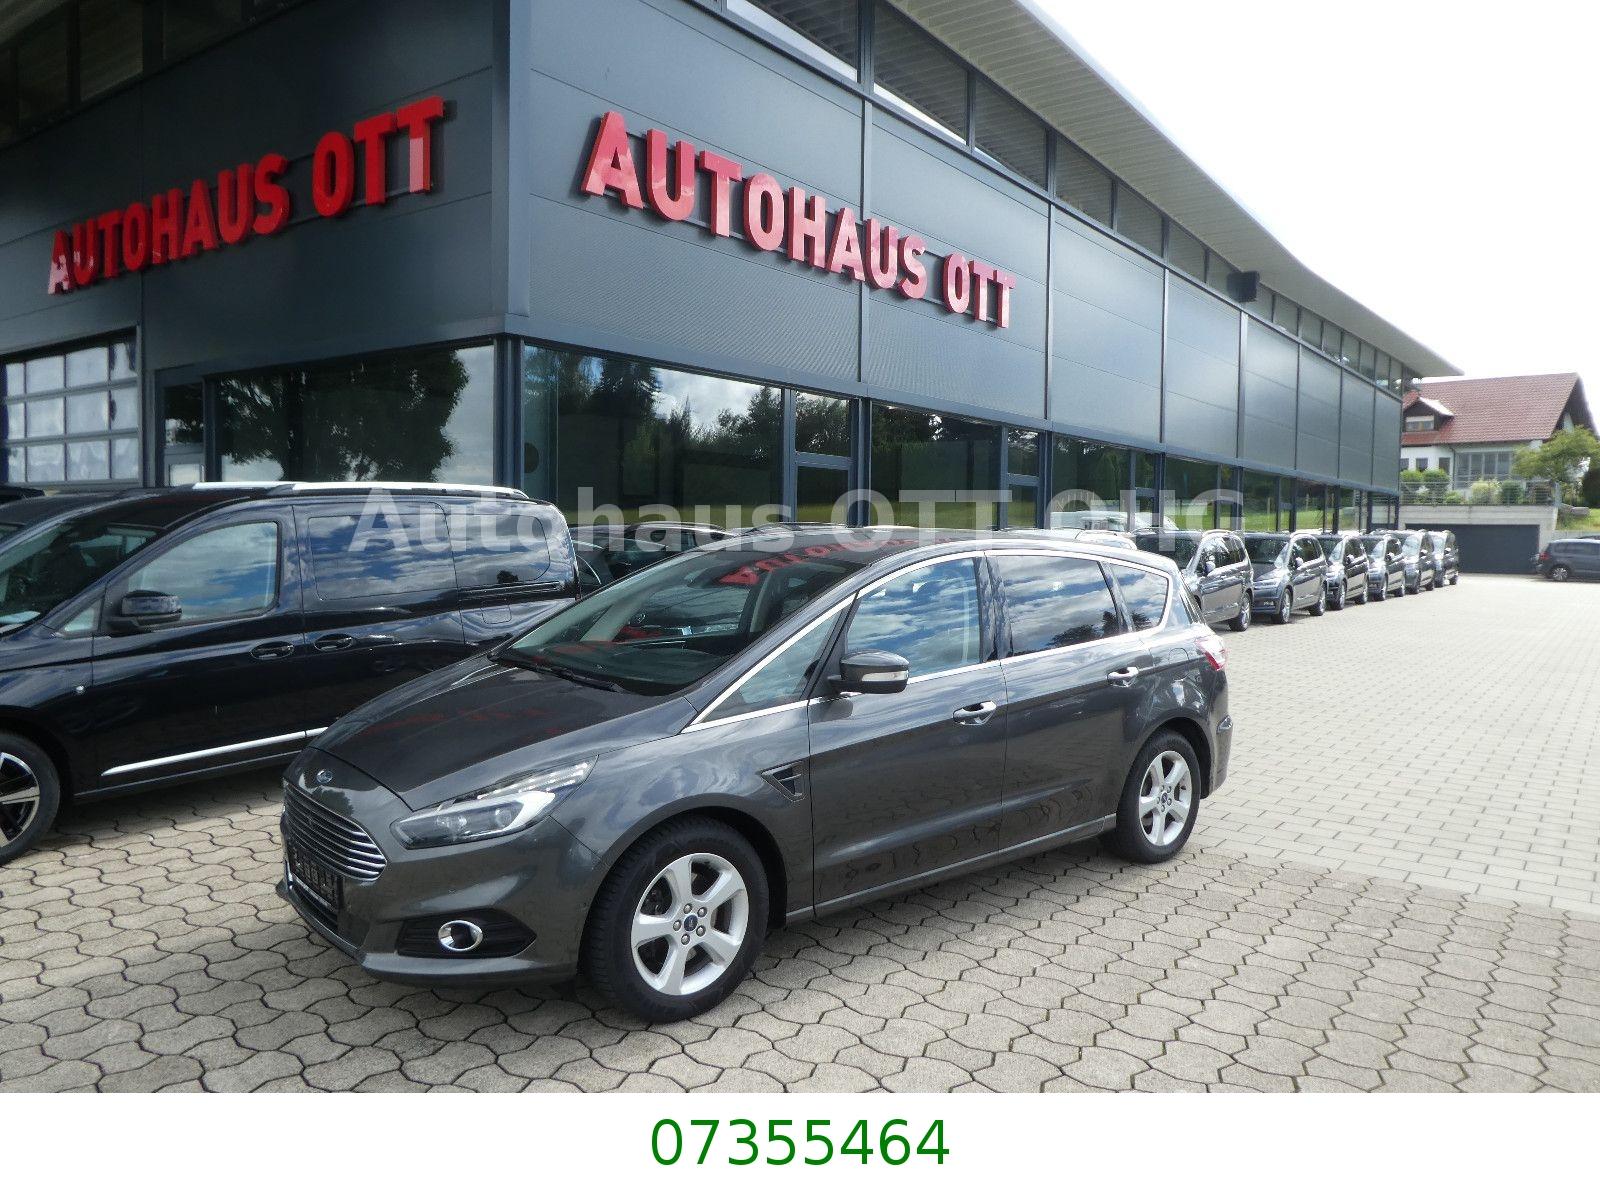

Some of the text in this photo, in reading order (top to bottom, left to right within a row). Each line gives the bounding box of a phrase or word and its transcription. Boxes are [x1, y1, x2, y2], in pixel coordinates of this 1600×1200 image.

[48, 96, 446, 294] AUTOHAUS OTT
[581, 111, 1016, 328] AUTOHAUS OTT
